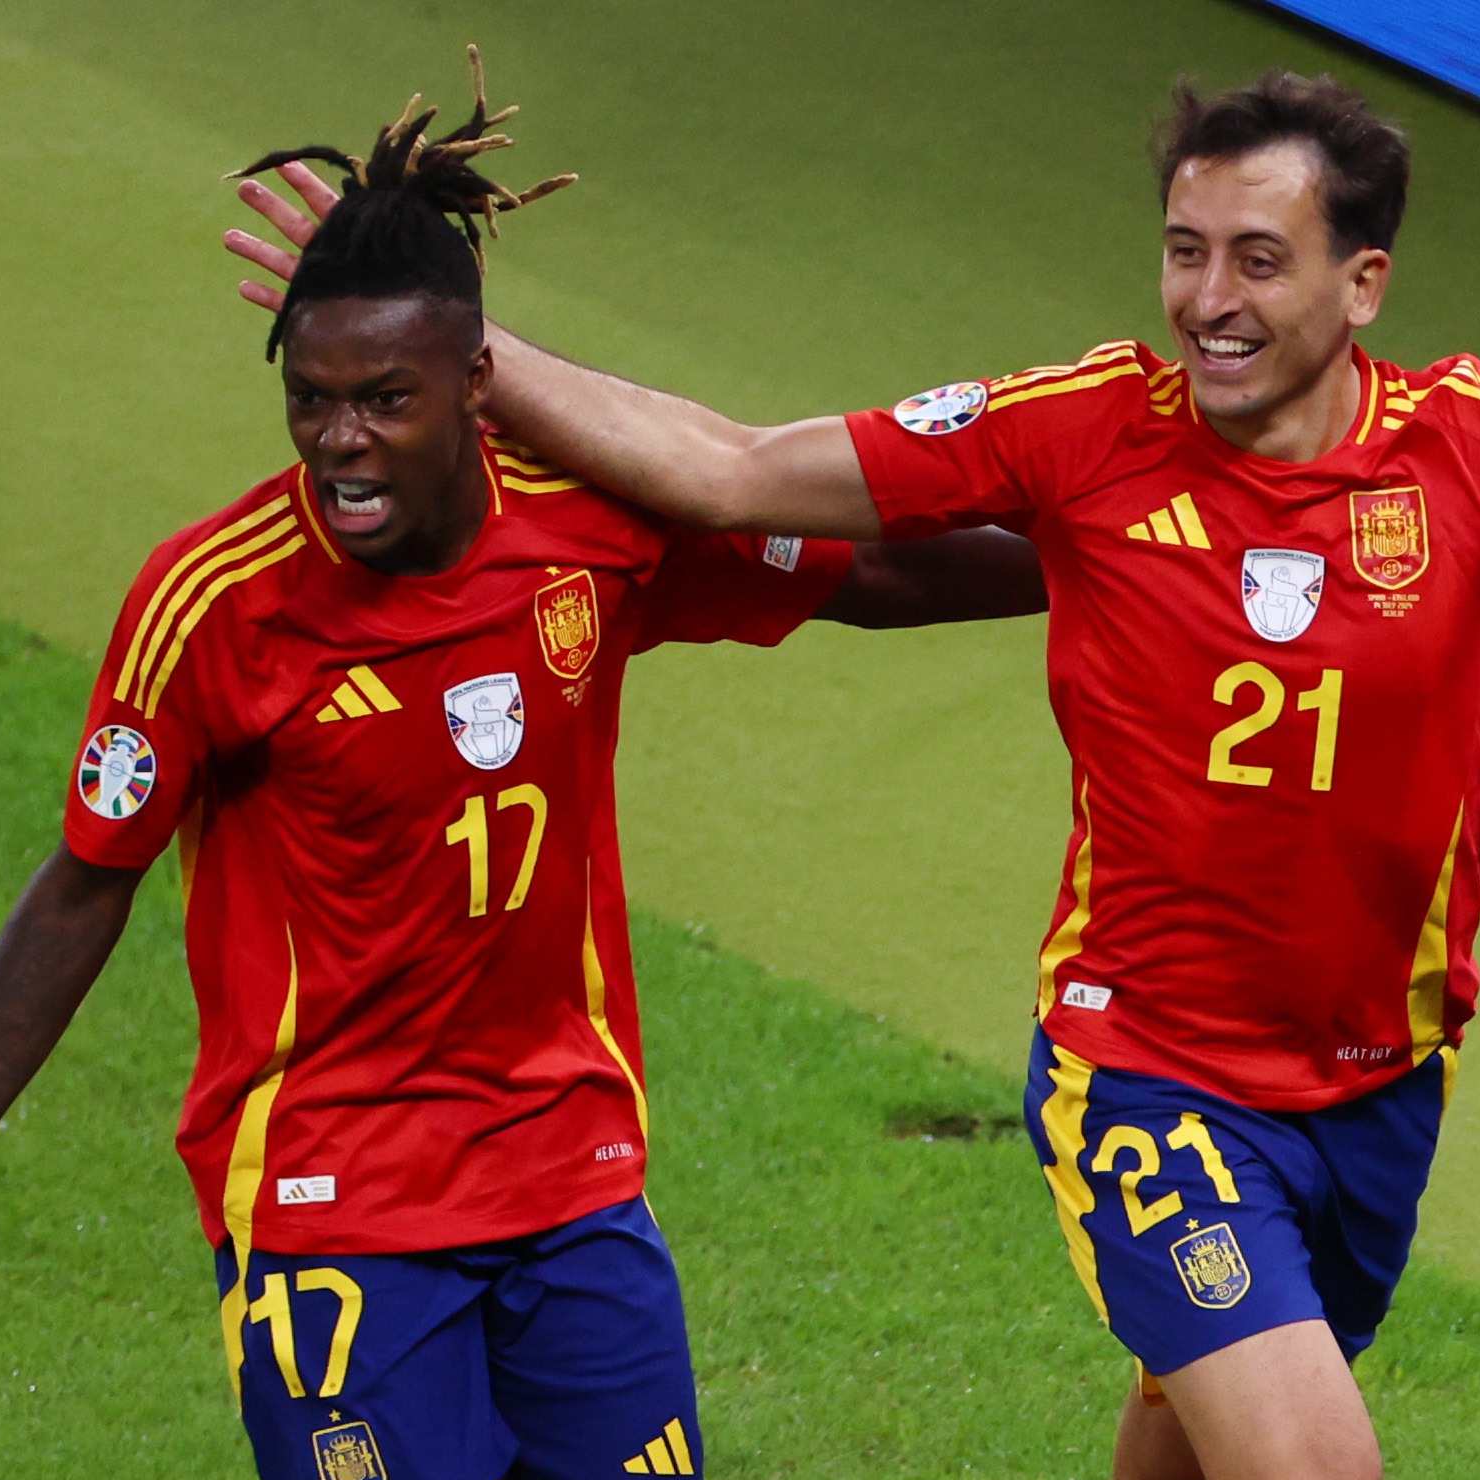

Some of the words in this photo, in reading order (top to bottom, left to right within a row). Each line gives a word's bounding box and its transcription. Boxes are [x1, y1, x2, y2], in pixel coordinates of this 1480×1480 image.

[1208, 661, 1343, 791] 21
[446, 783, 548, 917] 17
[1092, 1112, 1241, 1237] 21
[249, 1267, 363, 1399] 17
